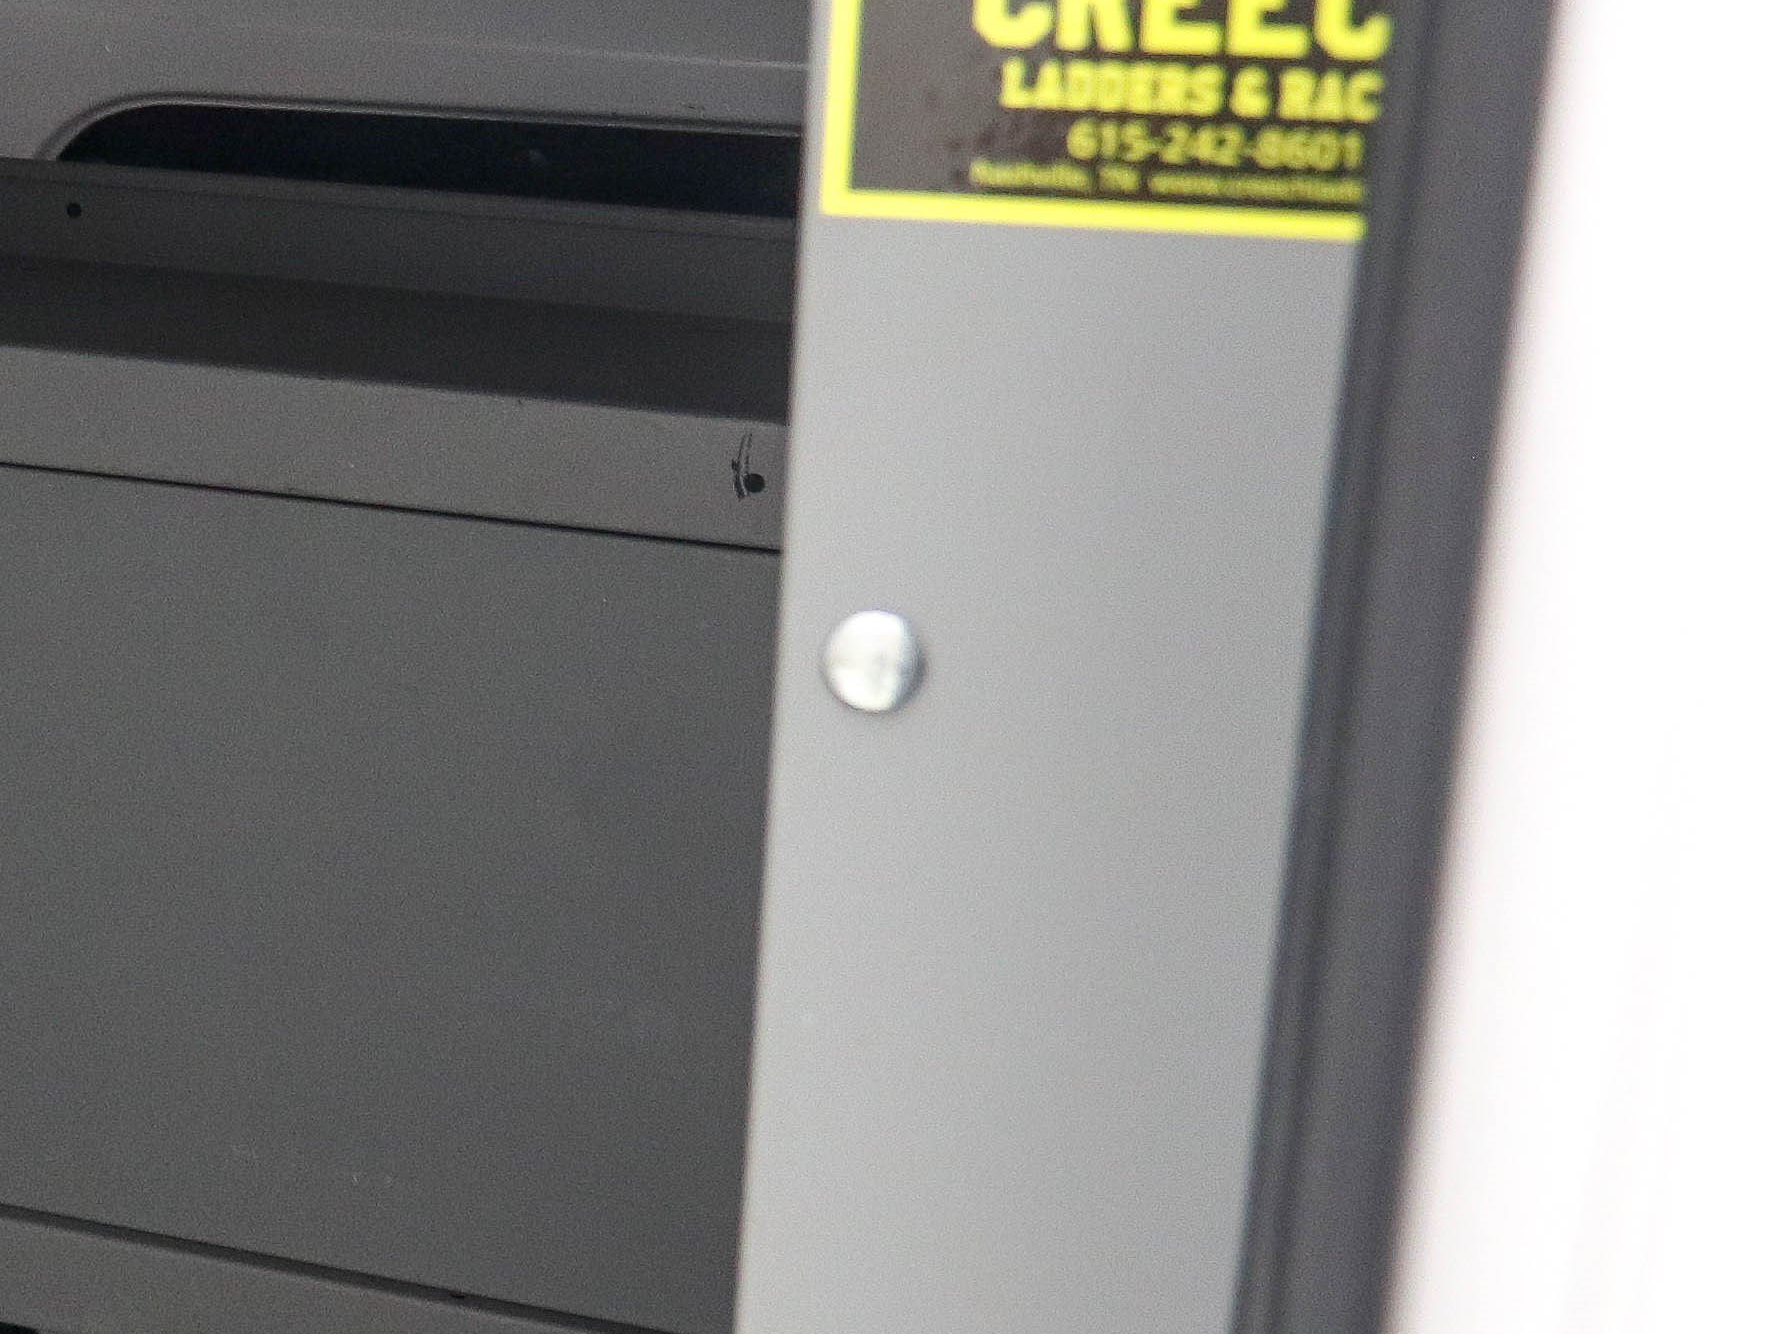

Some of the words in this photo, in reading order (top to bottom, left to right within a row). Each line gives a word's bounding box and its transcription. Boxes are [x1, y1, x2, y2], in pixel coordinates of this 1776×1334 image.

[1001, 58, 1225, 116] LADDERS
[1228, 66, 1271, 119] &
[1277, 68, 1385, 123] RAC
